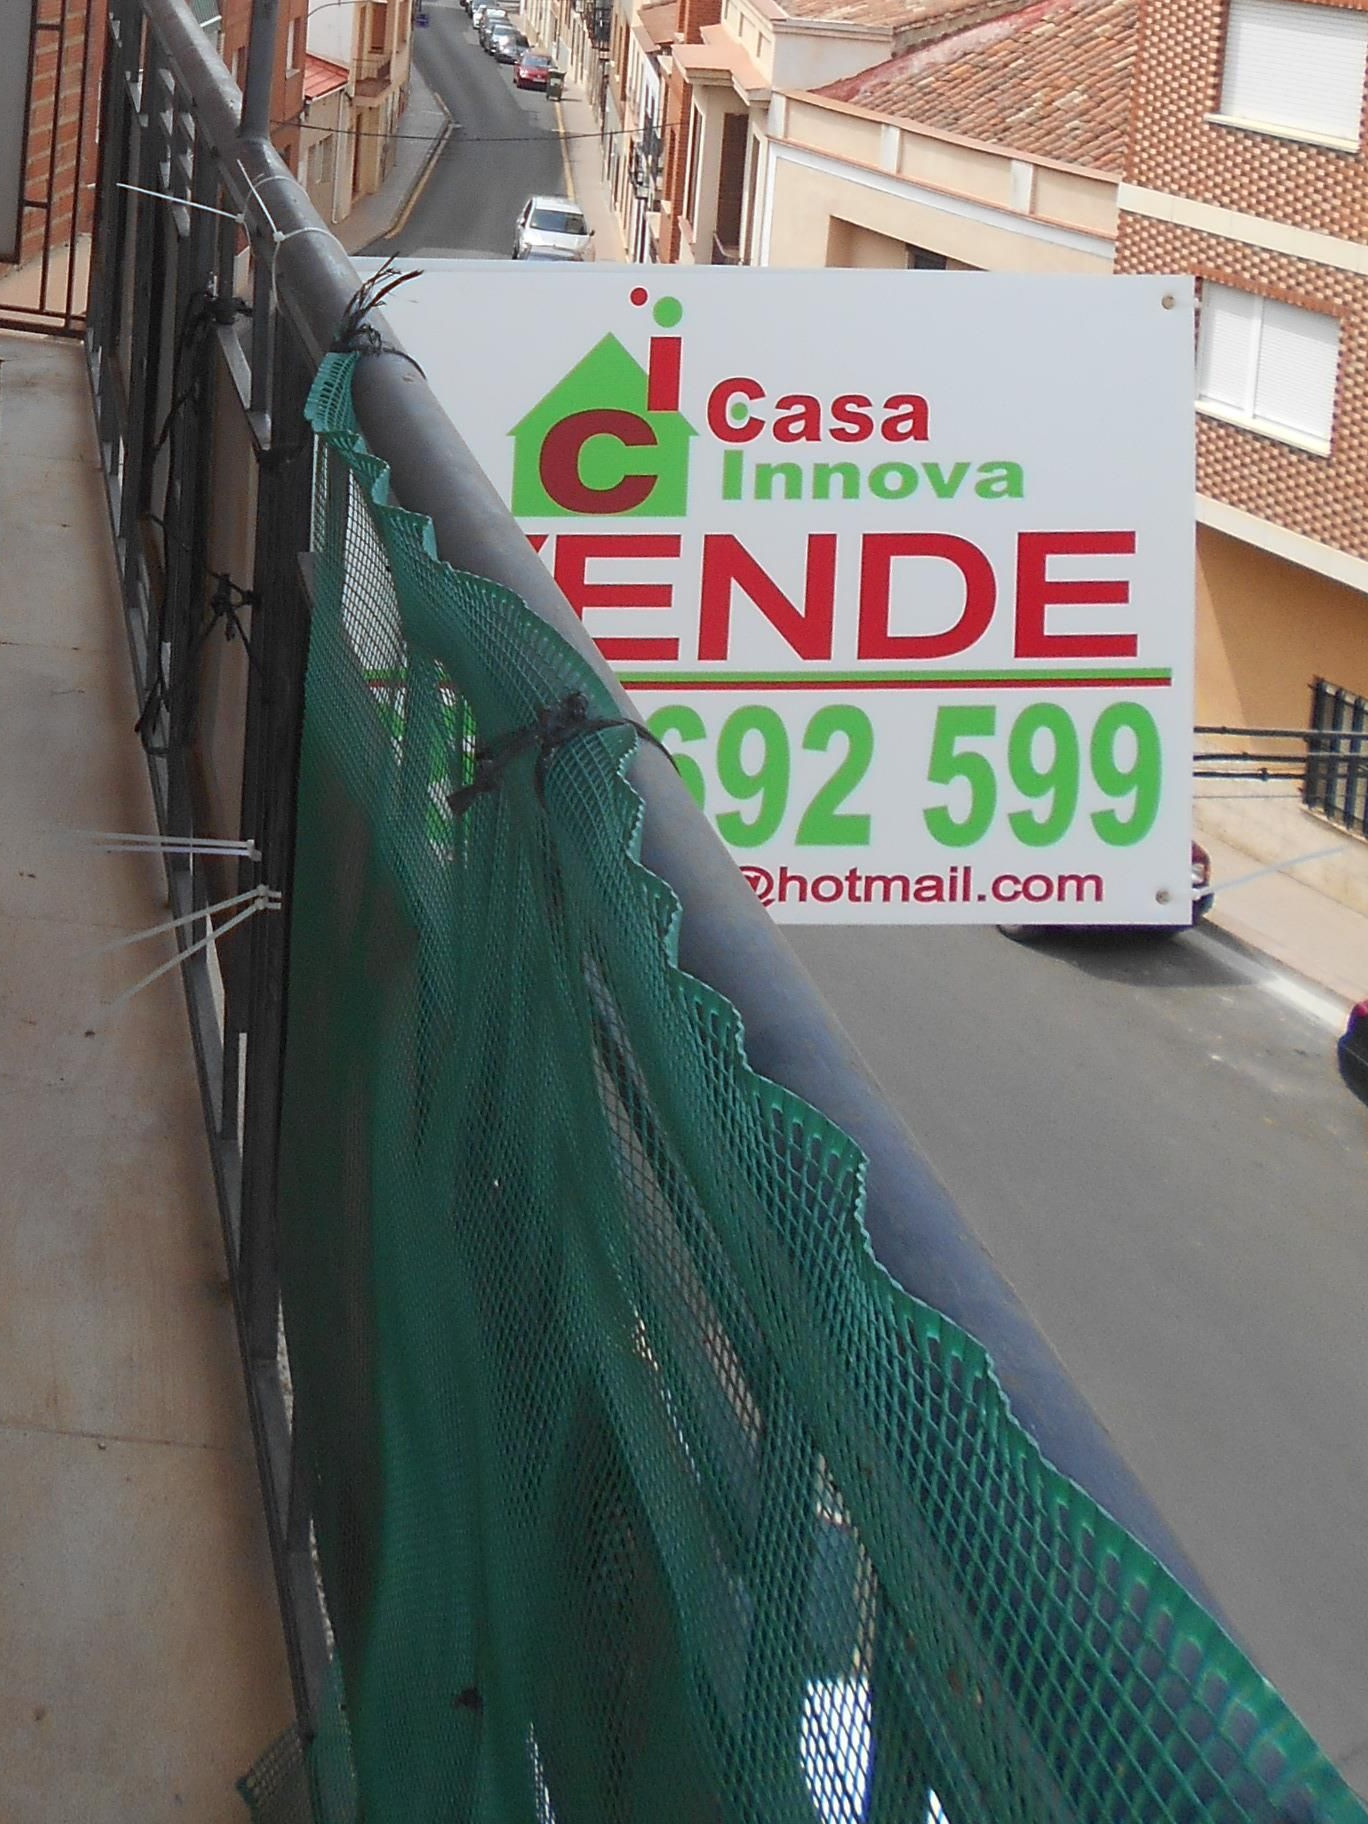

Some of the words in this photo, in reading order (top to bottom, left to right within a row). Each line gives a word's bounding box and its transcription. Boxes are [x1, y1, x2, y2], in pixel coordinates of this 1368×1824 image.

[706, 377, 930, 445] Casa
[722, 449, 1025, 501] Innova
[527, 531, 1138, 663] ENDE
[923, 702, 1162, 847] 599
